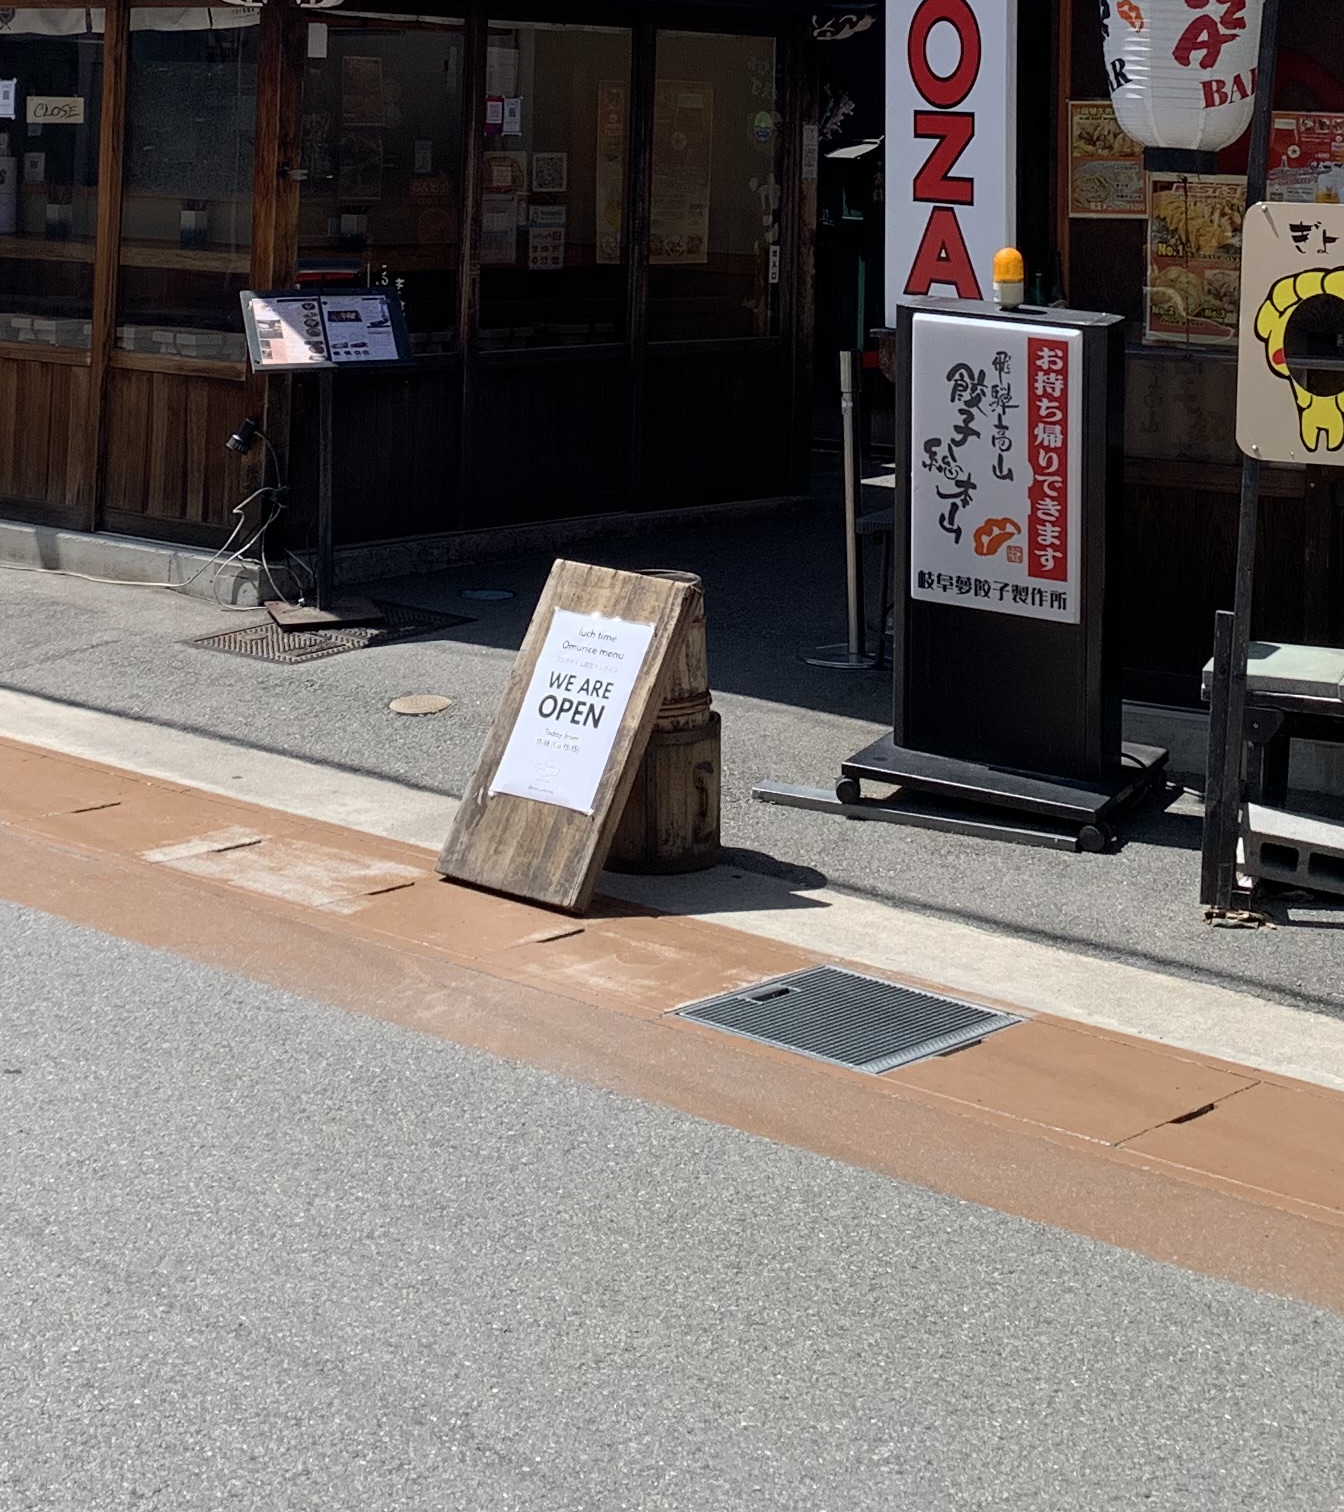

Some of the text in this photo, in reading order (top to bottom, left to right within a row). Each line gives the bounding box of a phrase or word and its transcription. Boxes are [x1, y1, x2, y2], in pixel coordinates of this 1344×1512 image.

[33, 103, 81, 118] CLOSE
[989, 350, 1020, 481] 飛騨高山
[922, 362, 989, 544] 餃子総本山
[1034, 346, 1064, 572] お持ち帰りできます
[917, 570, 1067, 611] 岐阜夢餃子製作所
[562, 640, 625, 661] Omurice menu
[549, 671, 614, 700] WE ARE
[538, 694, 606, 730] OPEN
